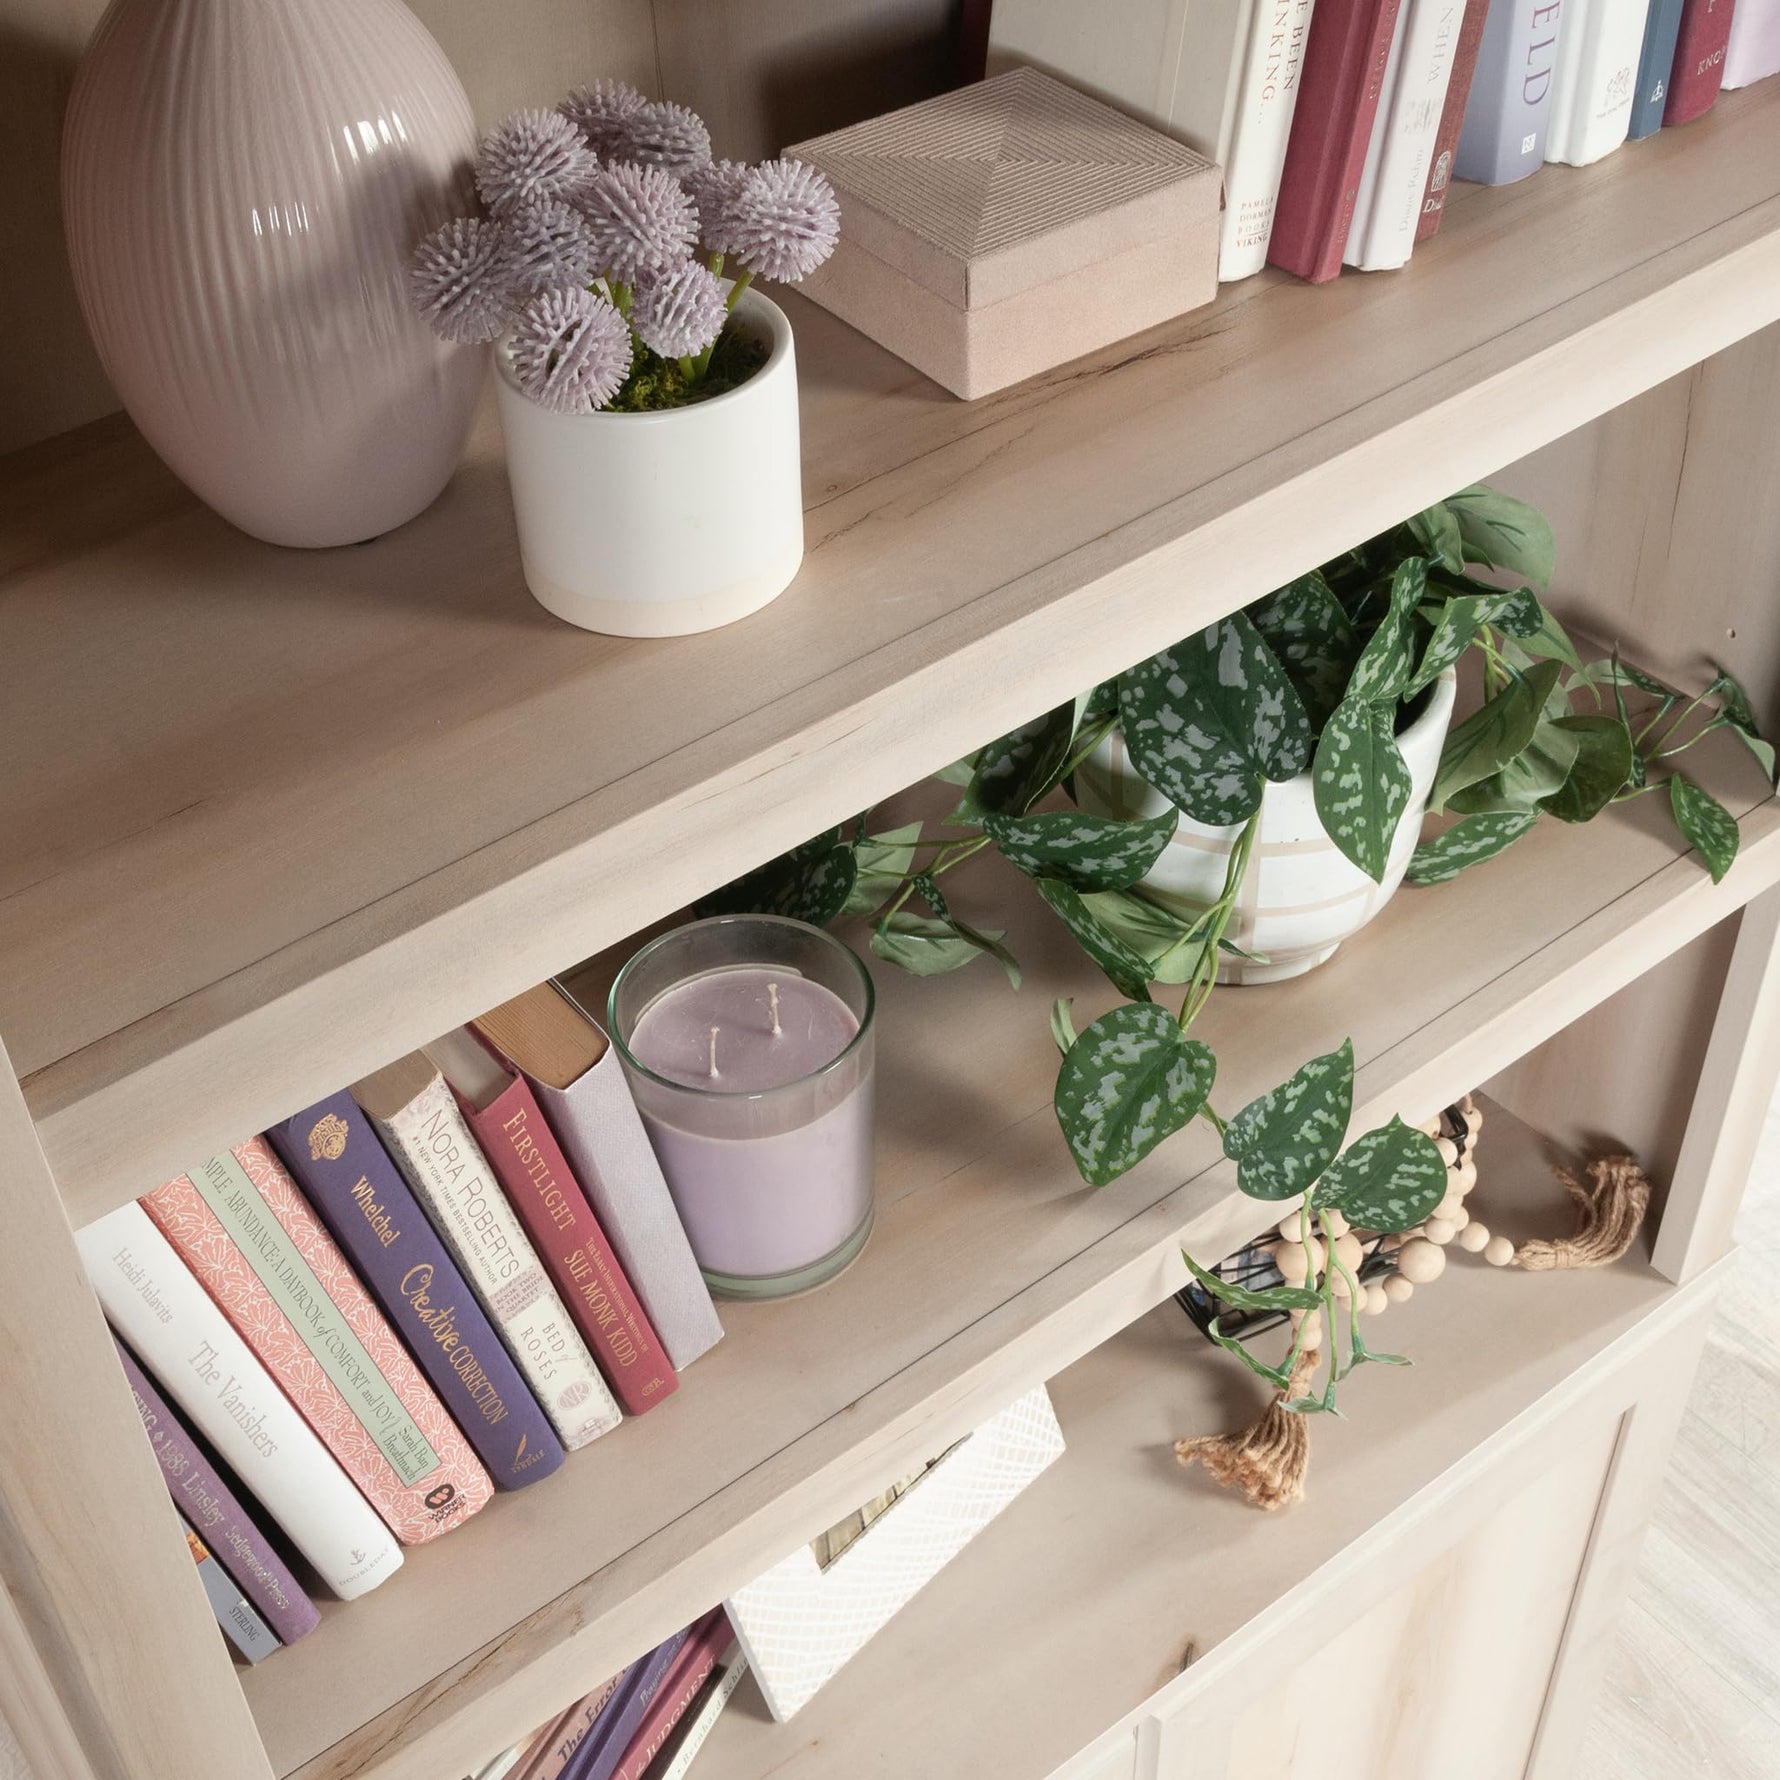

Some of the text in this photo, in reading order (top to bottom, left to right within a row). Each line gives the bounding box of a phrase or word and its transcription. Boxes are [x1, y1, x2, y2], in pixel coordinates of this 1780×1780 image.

[1284, 26, 1304, 90] BEEN
[1428, 7, 1454, 83] WHEN
[1523, 1, 1560, 105] ELD
[1697, 45, 1727, 75] KNO
[1236, 233, 1268, 248] VIKING
[350, 1174, 401, 1248] Whelchel
[418, 1146, 432, 1165] NEW
[428, 1164, 443, 1186] YORK
[440, 1185, 456, 1211] TIMES
[451, 1209, 482, 1257] BESTSELLING
[479, 1256, 498, 1285] AUTHOR
[421, 1108, 520, 1279] NORA ROBERTS
[112, 1247, 175, 1328] Heidi Julavits
[496, 1272, 538, 1304] BOOK TWO
[592, 1251, 607, 1272] EARLY
[202, 1157, 397, 1426] MPLE ABUNDANCE: A DAYBOOK of COMFORT and JOY
[504, 1294, 523, 1309] THE
[522, 1276, 545, 1298] BRIDE
[506, 1288, 540, 1313] QUARTET
[564, 1249, 638, 1367] SUE MONK KIDD
[400, 1263, 509, 1425] Creative CORRECTION
[521, 1327, 558, 1380] ROSES
[542, 1322, 566, 1352] BED
[187, 1340, 279, 1459] The Vanishers
[382, 1434, 423, 1482] Breathnach
[398, 1425, 430, 1470] Sarah Ban
[182, 1470, 225, 1528] Linsley
[428, 1493, 467, 1520] WARNER
[434, 1501, 467, 1524] BOOKS
[268, 1578, 291, 1610] Press
[229, 1606, 260, 1643] STERLING
[558, 1677, 618, 1761] The Error
[646, 1654, 716, 1760] JUDGMENT
[682, 1700, 723, 1765] Bernhard
[722, 1657, 750, 1699] Schlin
